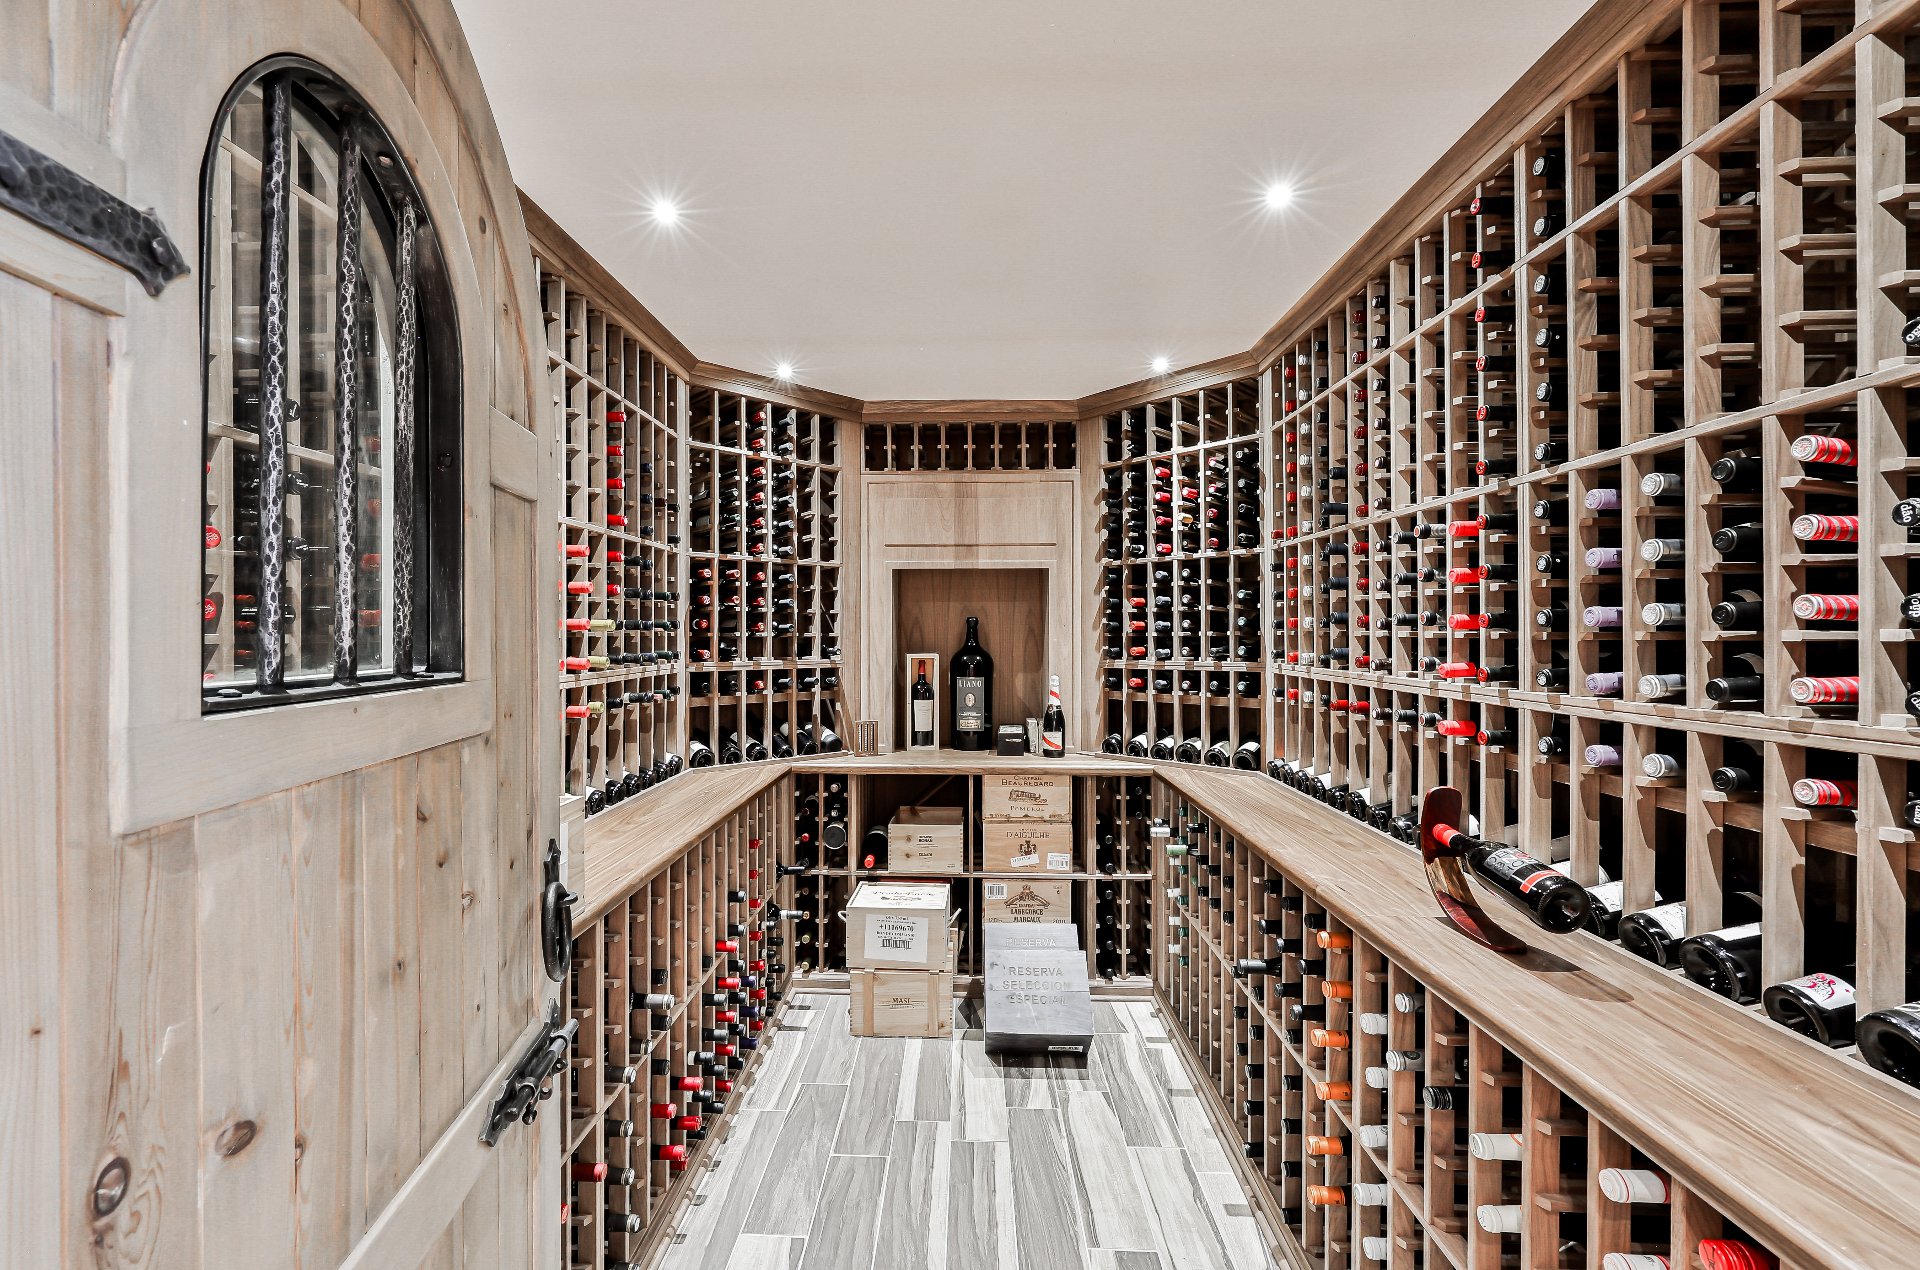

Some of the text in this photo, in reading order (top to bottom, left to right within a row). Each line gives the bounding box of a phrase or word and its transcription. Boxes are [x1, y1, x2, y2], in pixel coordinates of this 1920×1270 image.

[1900, 504, 1913, 523] dão
[1001, 779, 1054, 787] BEAUREGARD
[1008, 966, 1064, 977] RESERVA
[1008, 993, 1069, 1006] ESPECIAL
